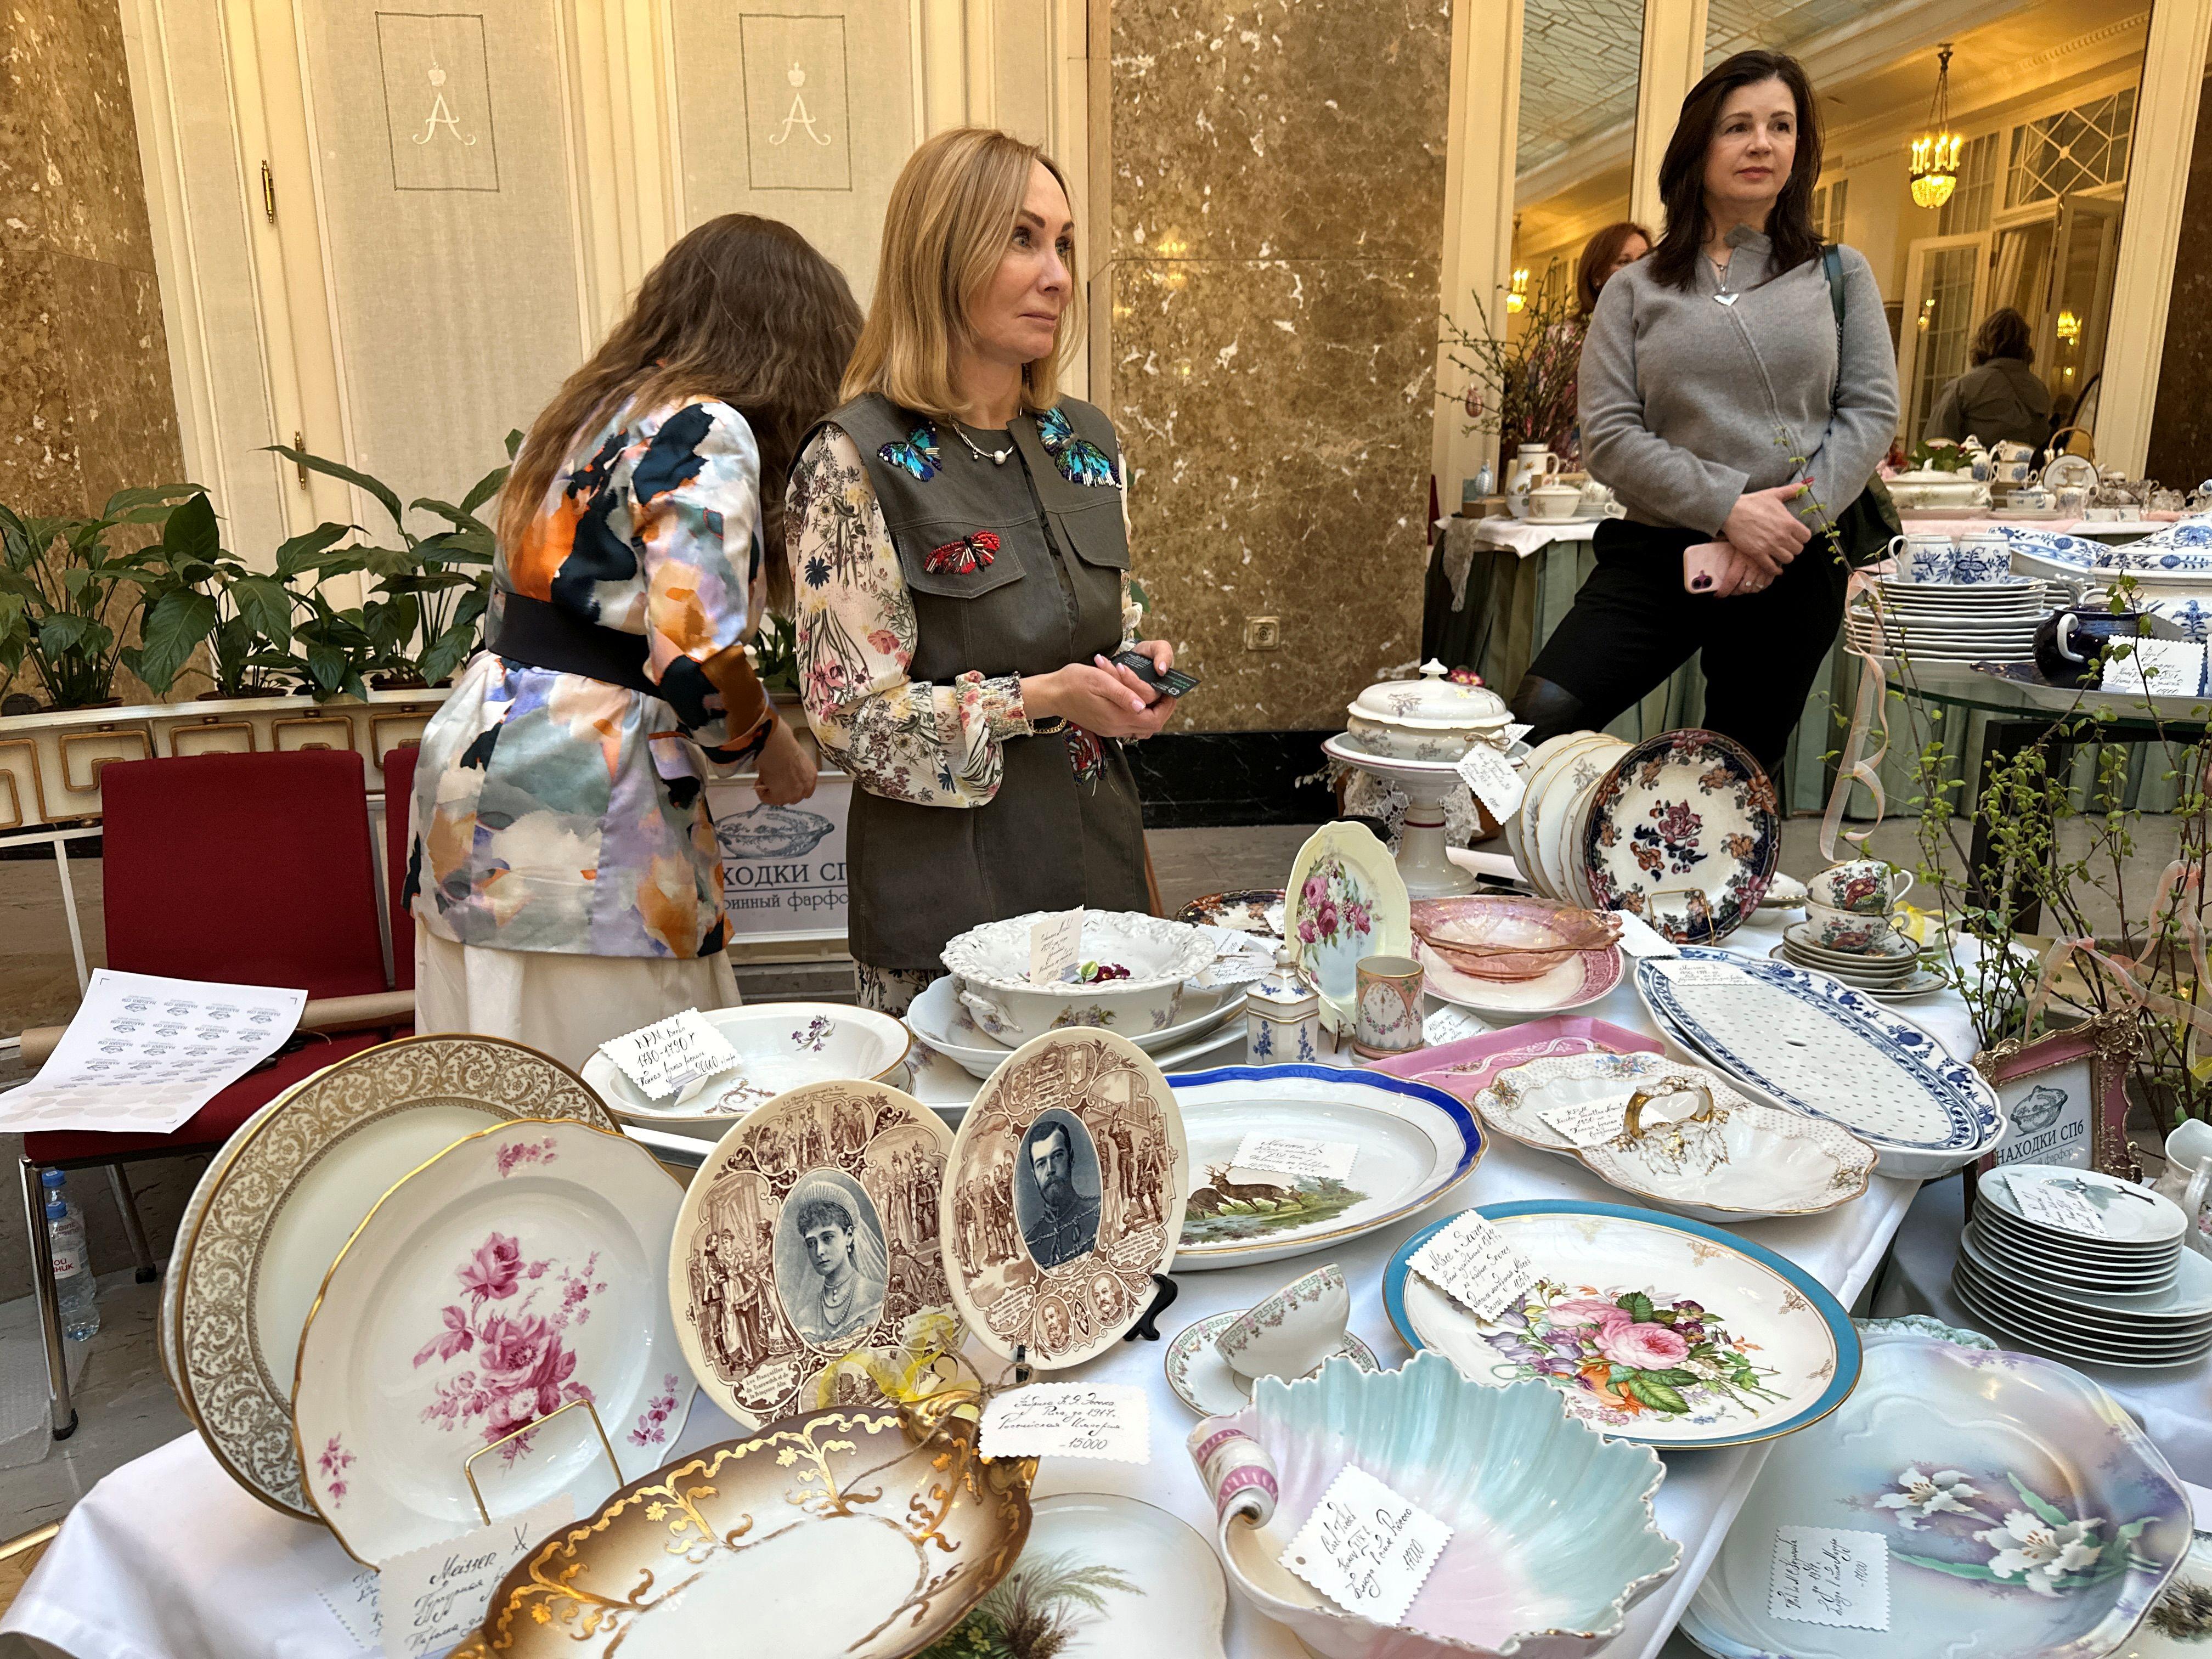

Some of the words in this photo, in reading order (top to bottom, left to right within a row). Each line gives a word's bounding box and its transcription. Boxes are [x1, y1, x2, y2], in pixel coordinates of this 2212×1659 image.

[724, 864, 809, 887] ХОДКИ
[787, 889, 849, 911] фарфо
[634, 1029, 664, 1049] KPM
[1996, 1130, 2056, 1166] НАХОДКИ
[2061, 1119, 2084, 1141] СПб
